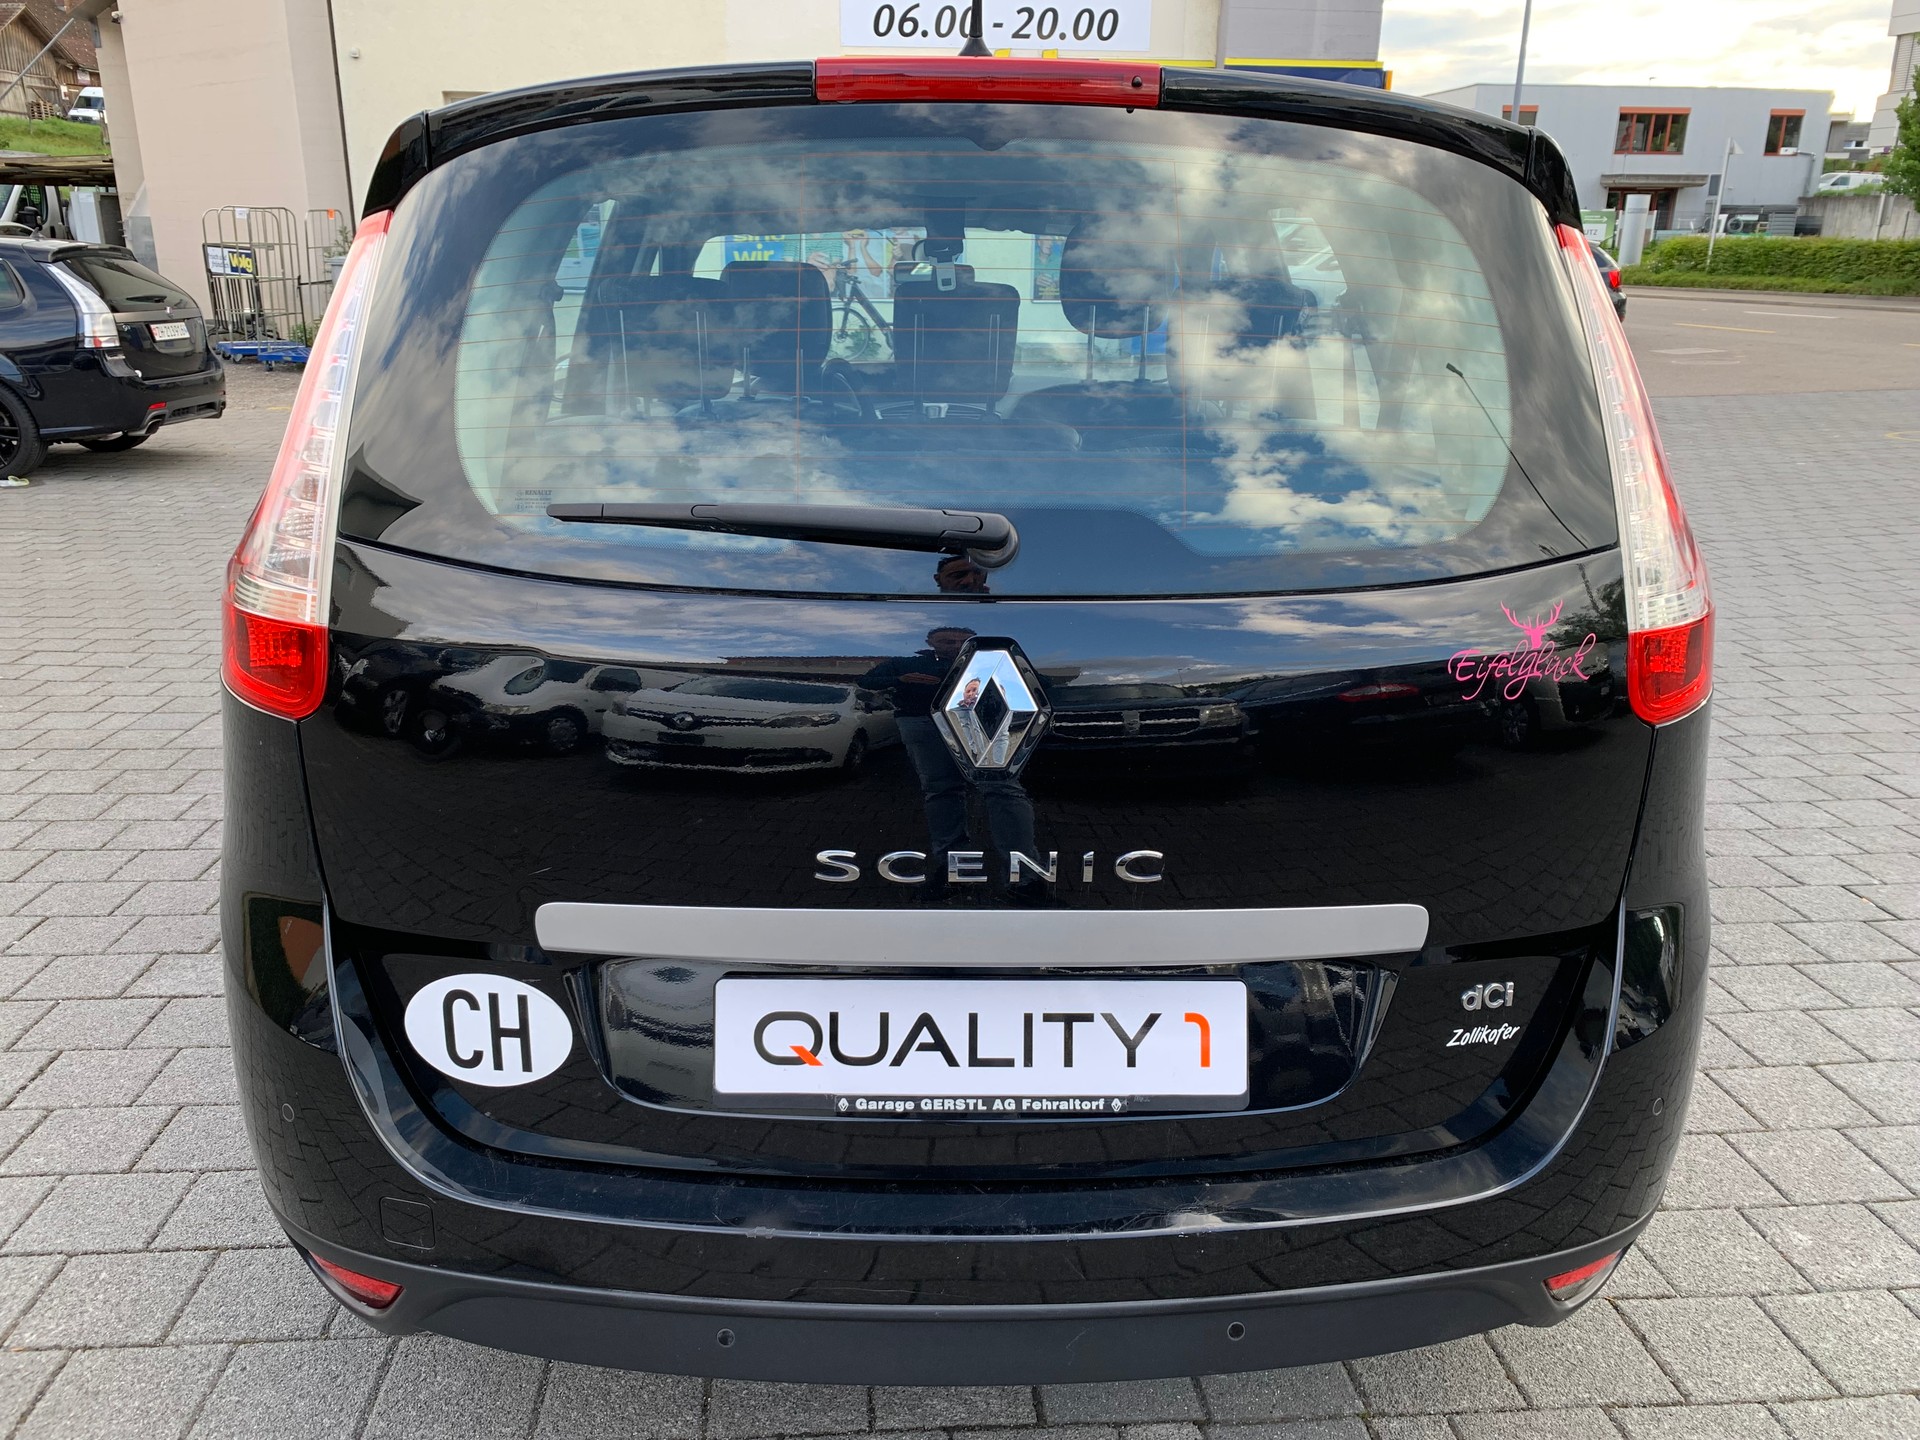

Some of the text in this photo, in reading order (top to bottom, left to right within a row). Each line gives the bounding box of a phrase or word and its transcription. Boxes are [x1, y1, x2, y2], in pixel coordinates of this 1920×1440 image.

[1011, 6, 1119, 41] 20.00
[229, 252, 253, 273] Volg
[732, 243, 775, 262] wir
[1447, 632, 1597, 701] Eifelglück
[814, 849, 1165, 884] SCENIC
[442, 988, 533, 1073] CH
[753, 1010, 1211, 1068] QUALITY 1
[1445, 1022, 1521, 1048] Zollikofer
[855, 1097, 1105, 1113] Garage GERSTL AG Fehraltorf
